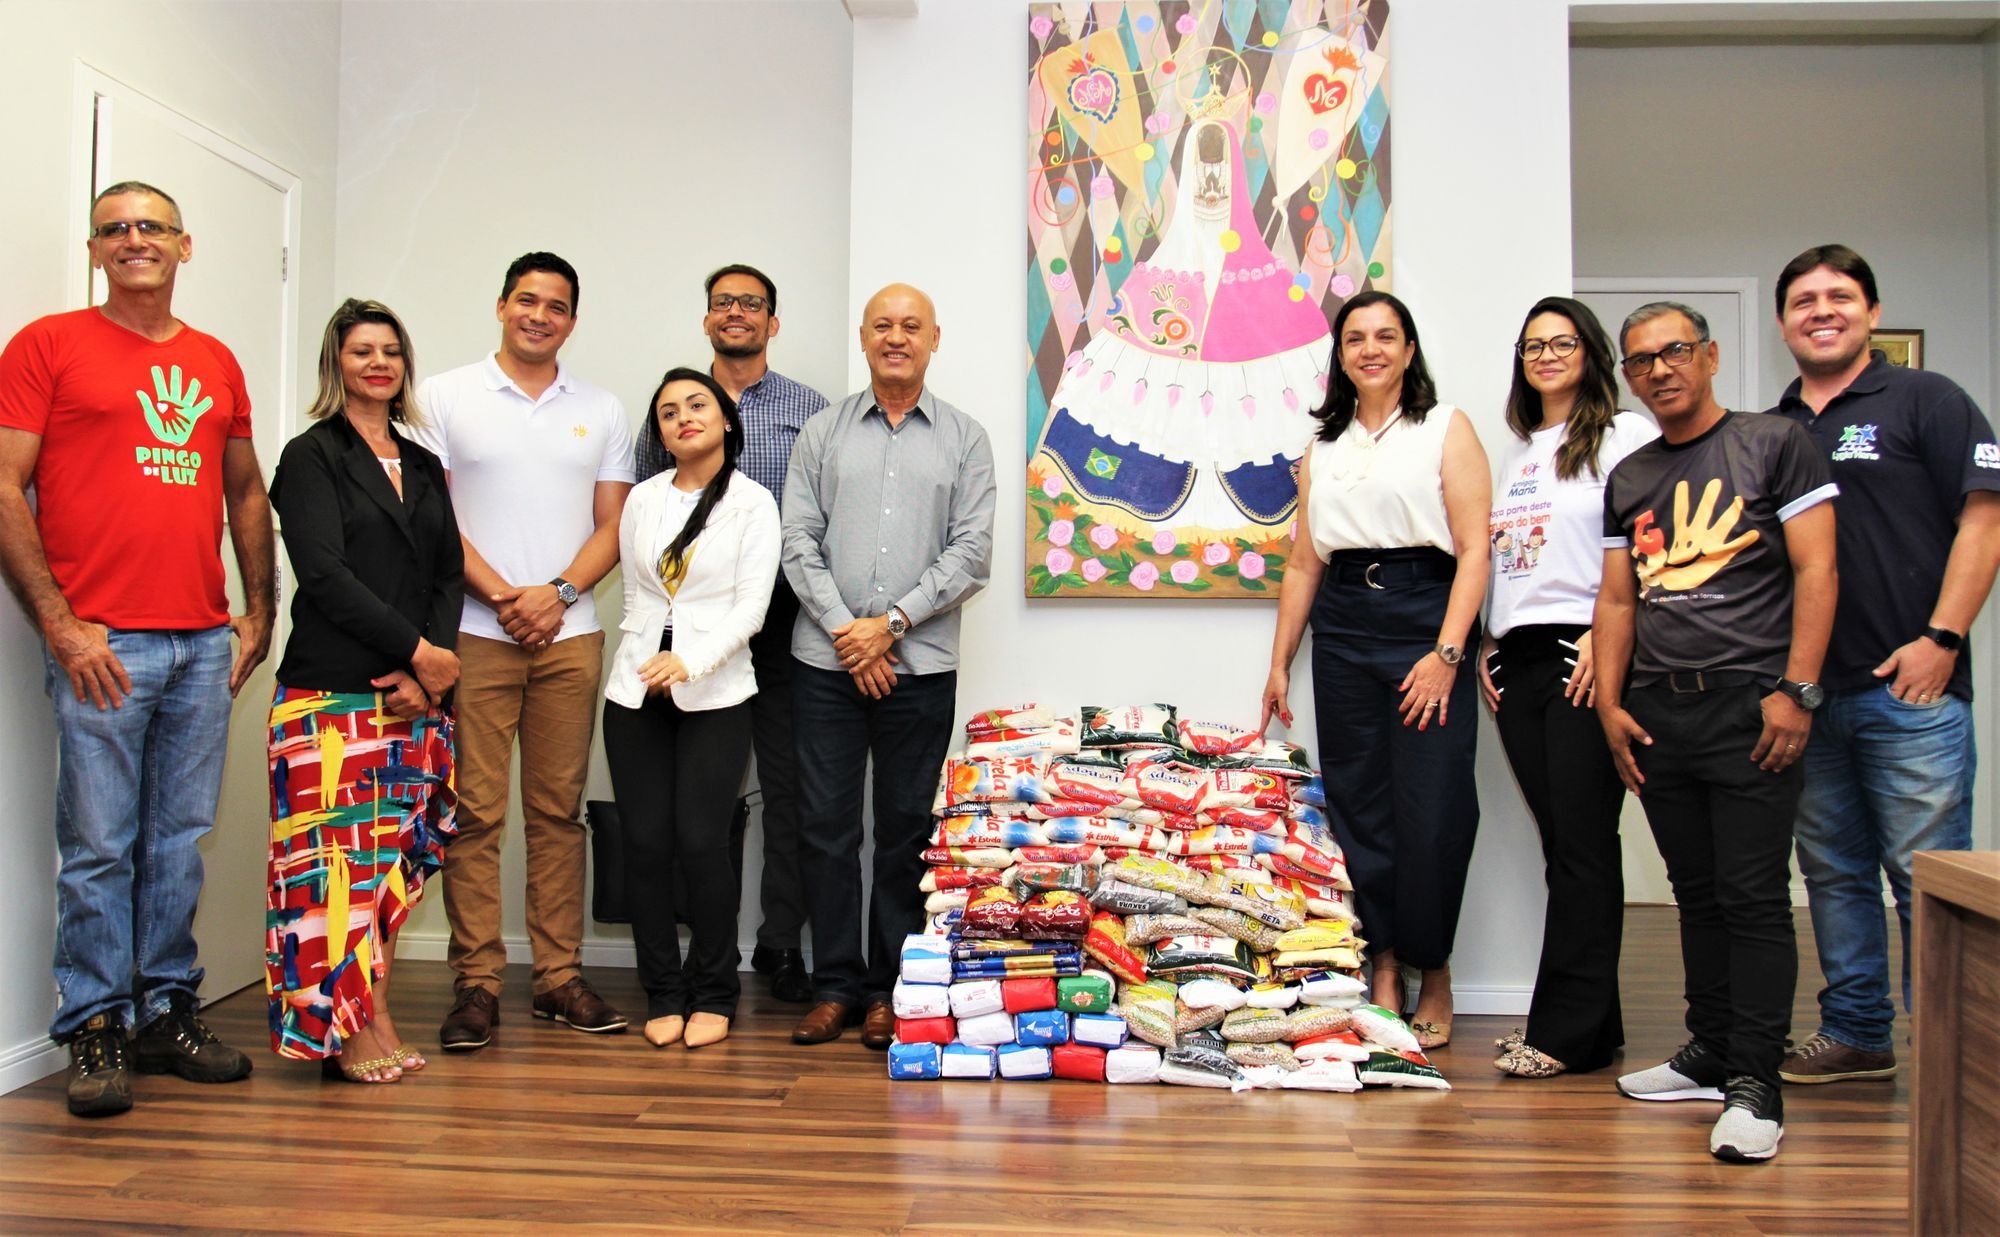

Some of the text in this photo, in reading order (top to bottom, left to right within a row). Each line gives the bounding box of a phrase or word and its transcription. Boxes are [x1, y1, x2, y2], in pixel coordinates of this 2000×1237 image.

[135, 446, 201, 469] PINGO
[143, 466, 197, 486] DE LUZ
[1508, 486, 1537, 498] Maria
[1506, 505, 1528, 517] parte
[1530, 501, 1552, 511] deste
[1516, 516, 1528, 528] do
[1530, 514, 1551, 526] bem
[1224, 843, 1248, 851] Estrela
[1119, 901, 1147, 910] SAKURA
[1260, 912, 1281, 925] BETA
